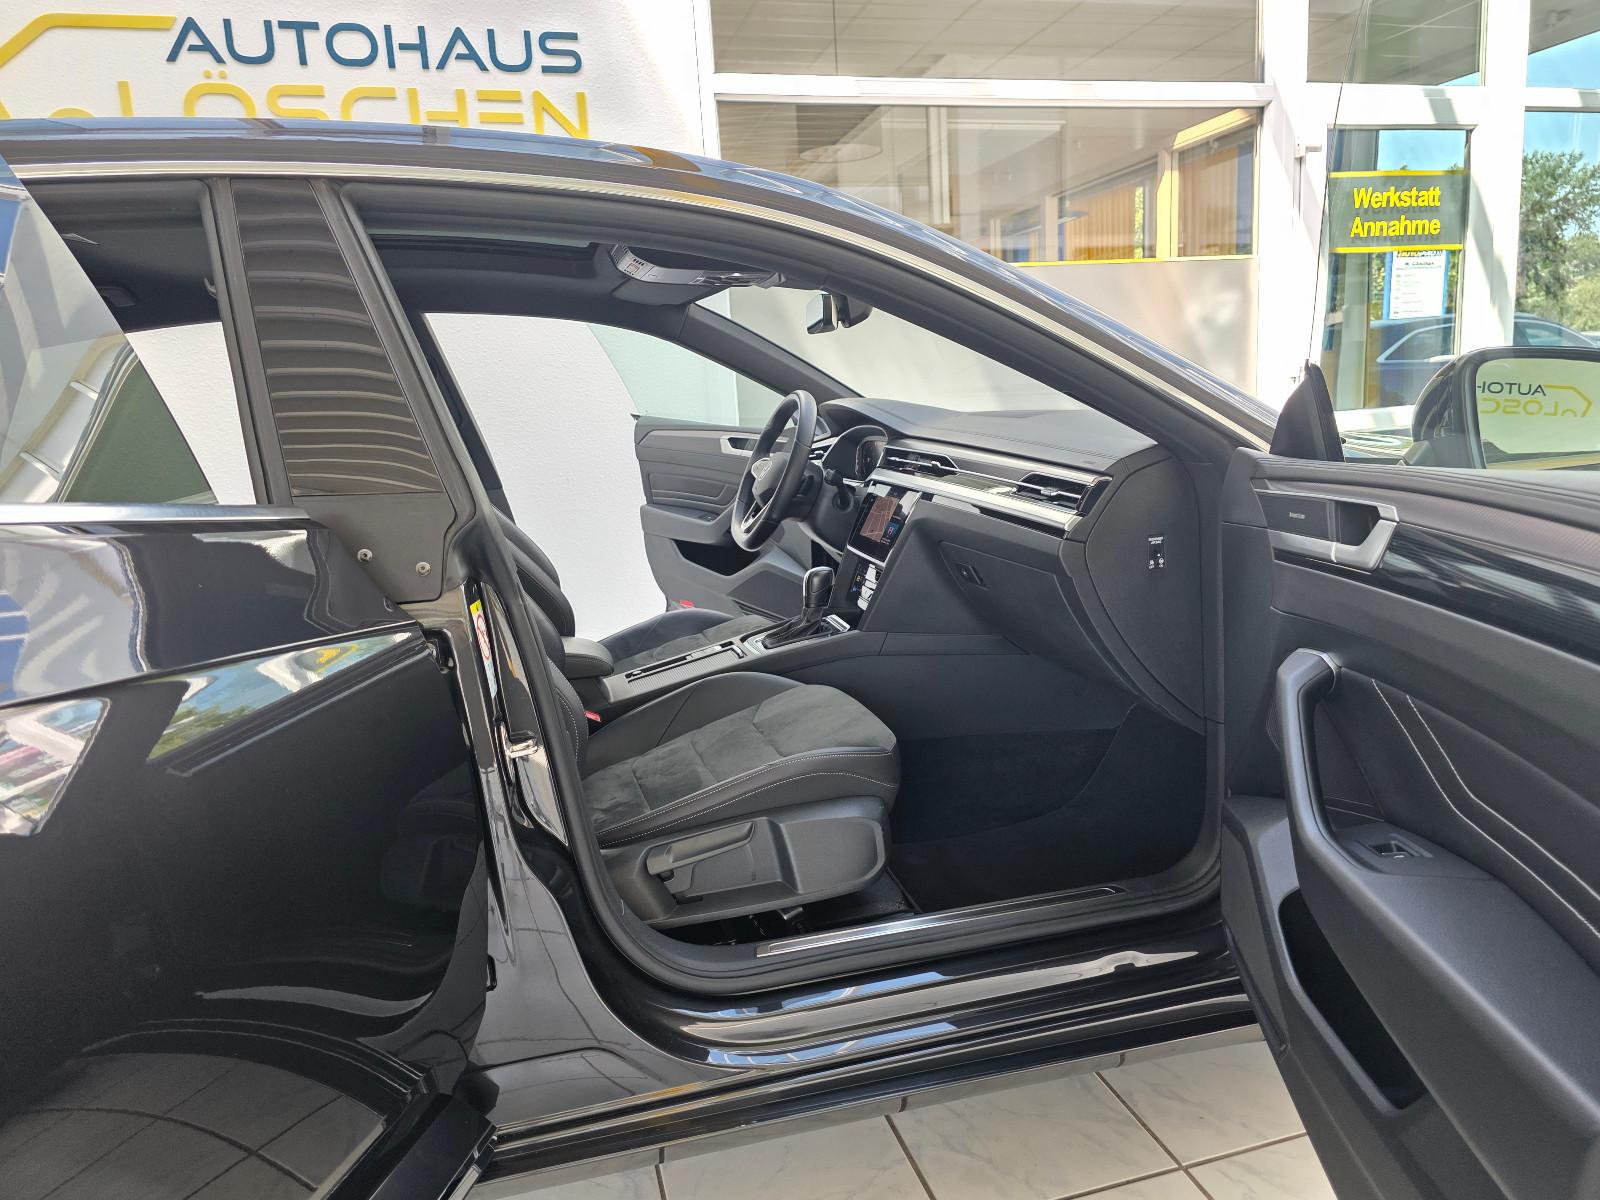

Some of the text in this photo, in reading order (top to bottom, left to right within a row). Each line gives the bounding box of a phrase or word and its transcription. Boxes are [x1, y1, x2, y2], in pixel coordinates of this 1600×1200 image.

[166, 16, 582, 75] AUTOHAUS
[1353, 186, 1441, 209] Werkstatt
[1350, 215, 1441, 238] Annahme
